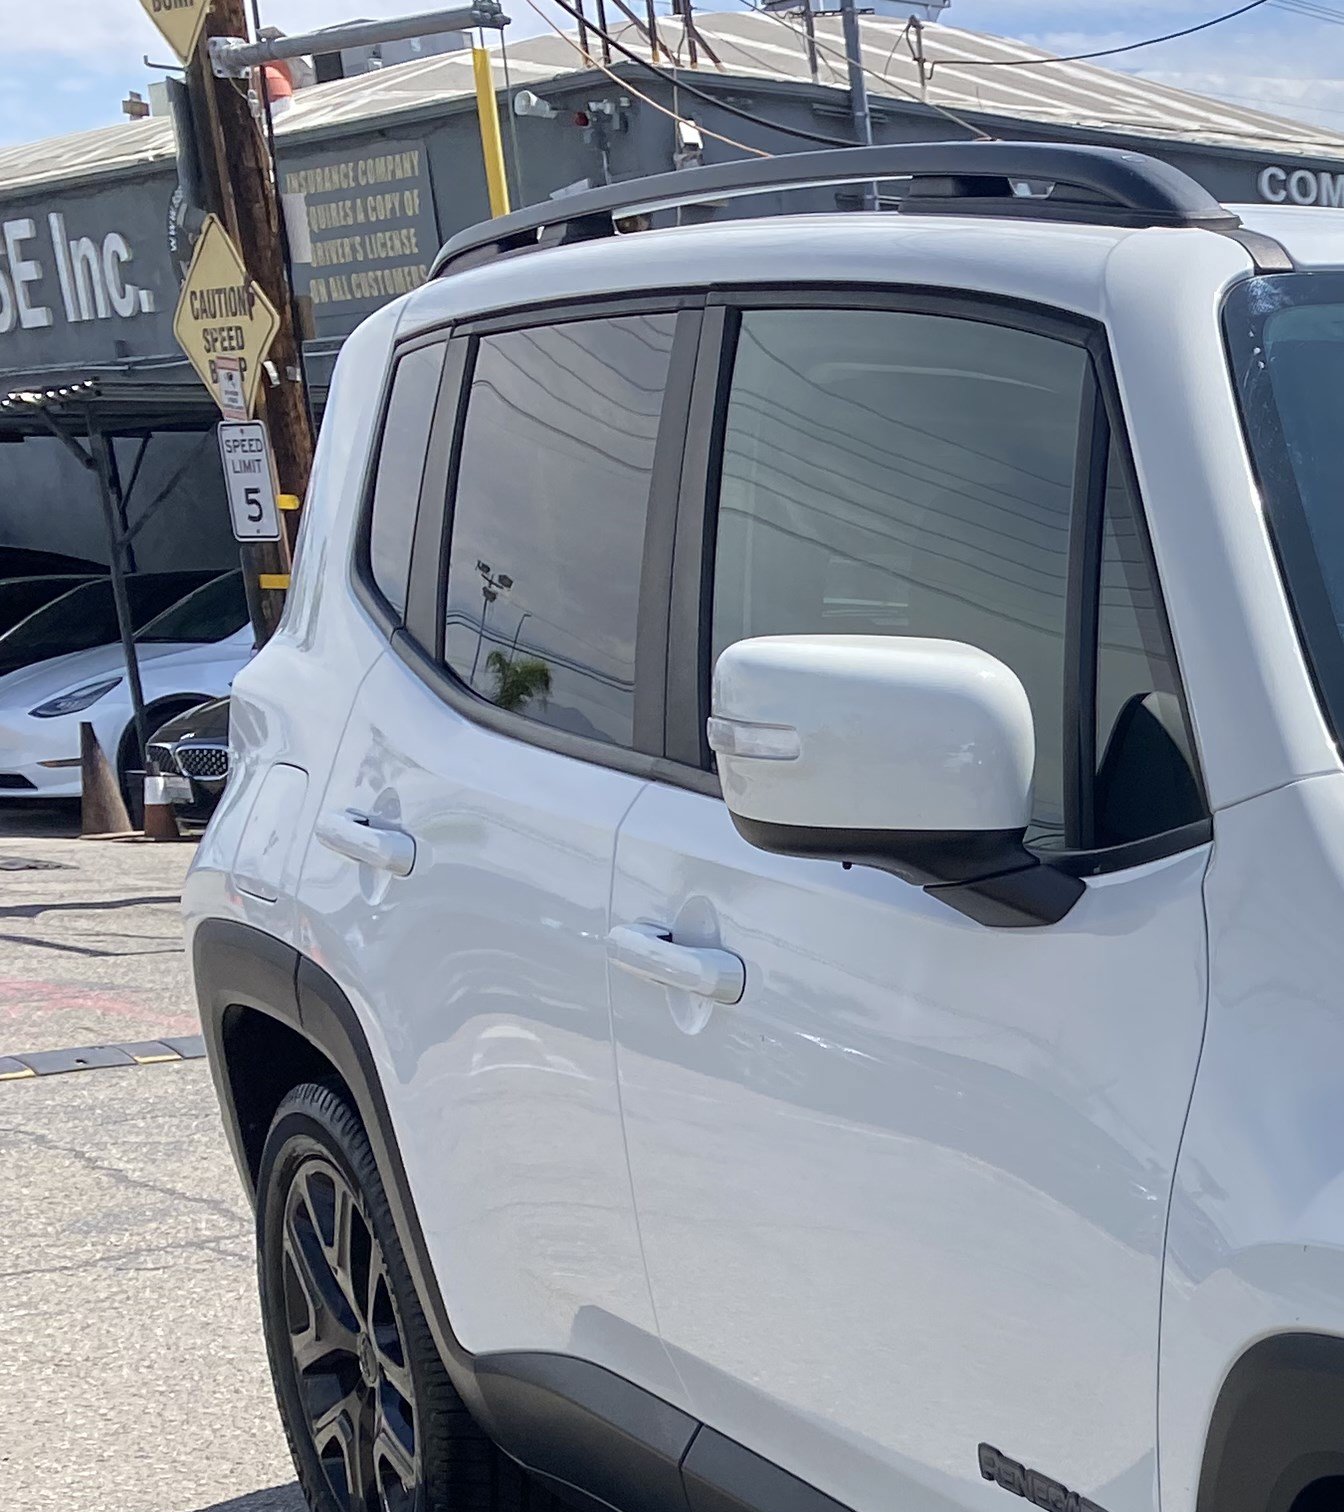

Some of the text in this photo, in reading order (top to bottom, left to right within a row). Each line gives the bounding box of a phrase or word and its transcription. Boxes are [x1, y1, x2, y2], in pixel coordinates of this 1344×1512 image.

[286, 150, 419, 194] INSURANCE COMPANY
[356, 198, 366, 223] A
[367, 191, 400, 222] COPY
[404, 189, 420, 216] OF
[311, 228, 419, 267] DRIVER'S LICENSE
[48, 212, 155, 323] Inc.
[329, 275, 352, 301] ALL
[351, 264, 428, 298] CUSTOMERS
[202, 325, 245, 353] SPEED
[208, 357, 248, 384] BP
[224, 438, 263, 453] SPEED
[232, 459, 262, 474] LIMIT
[244, 488, 263, 522] 5
